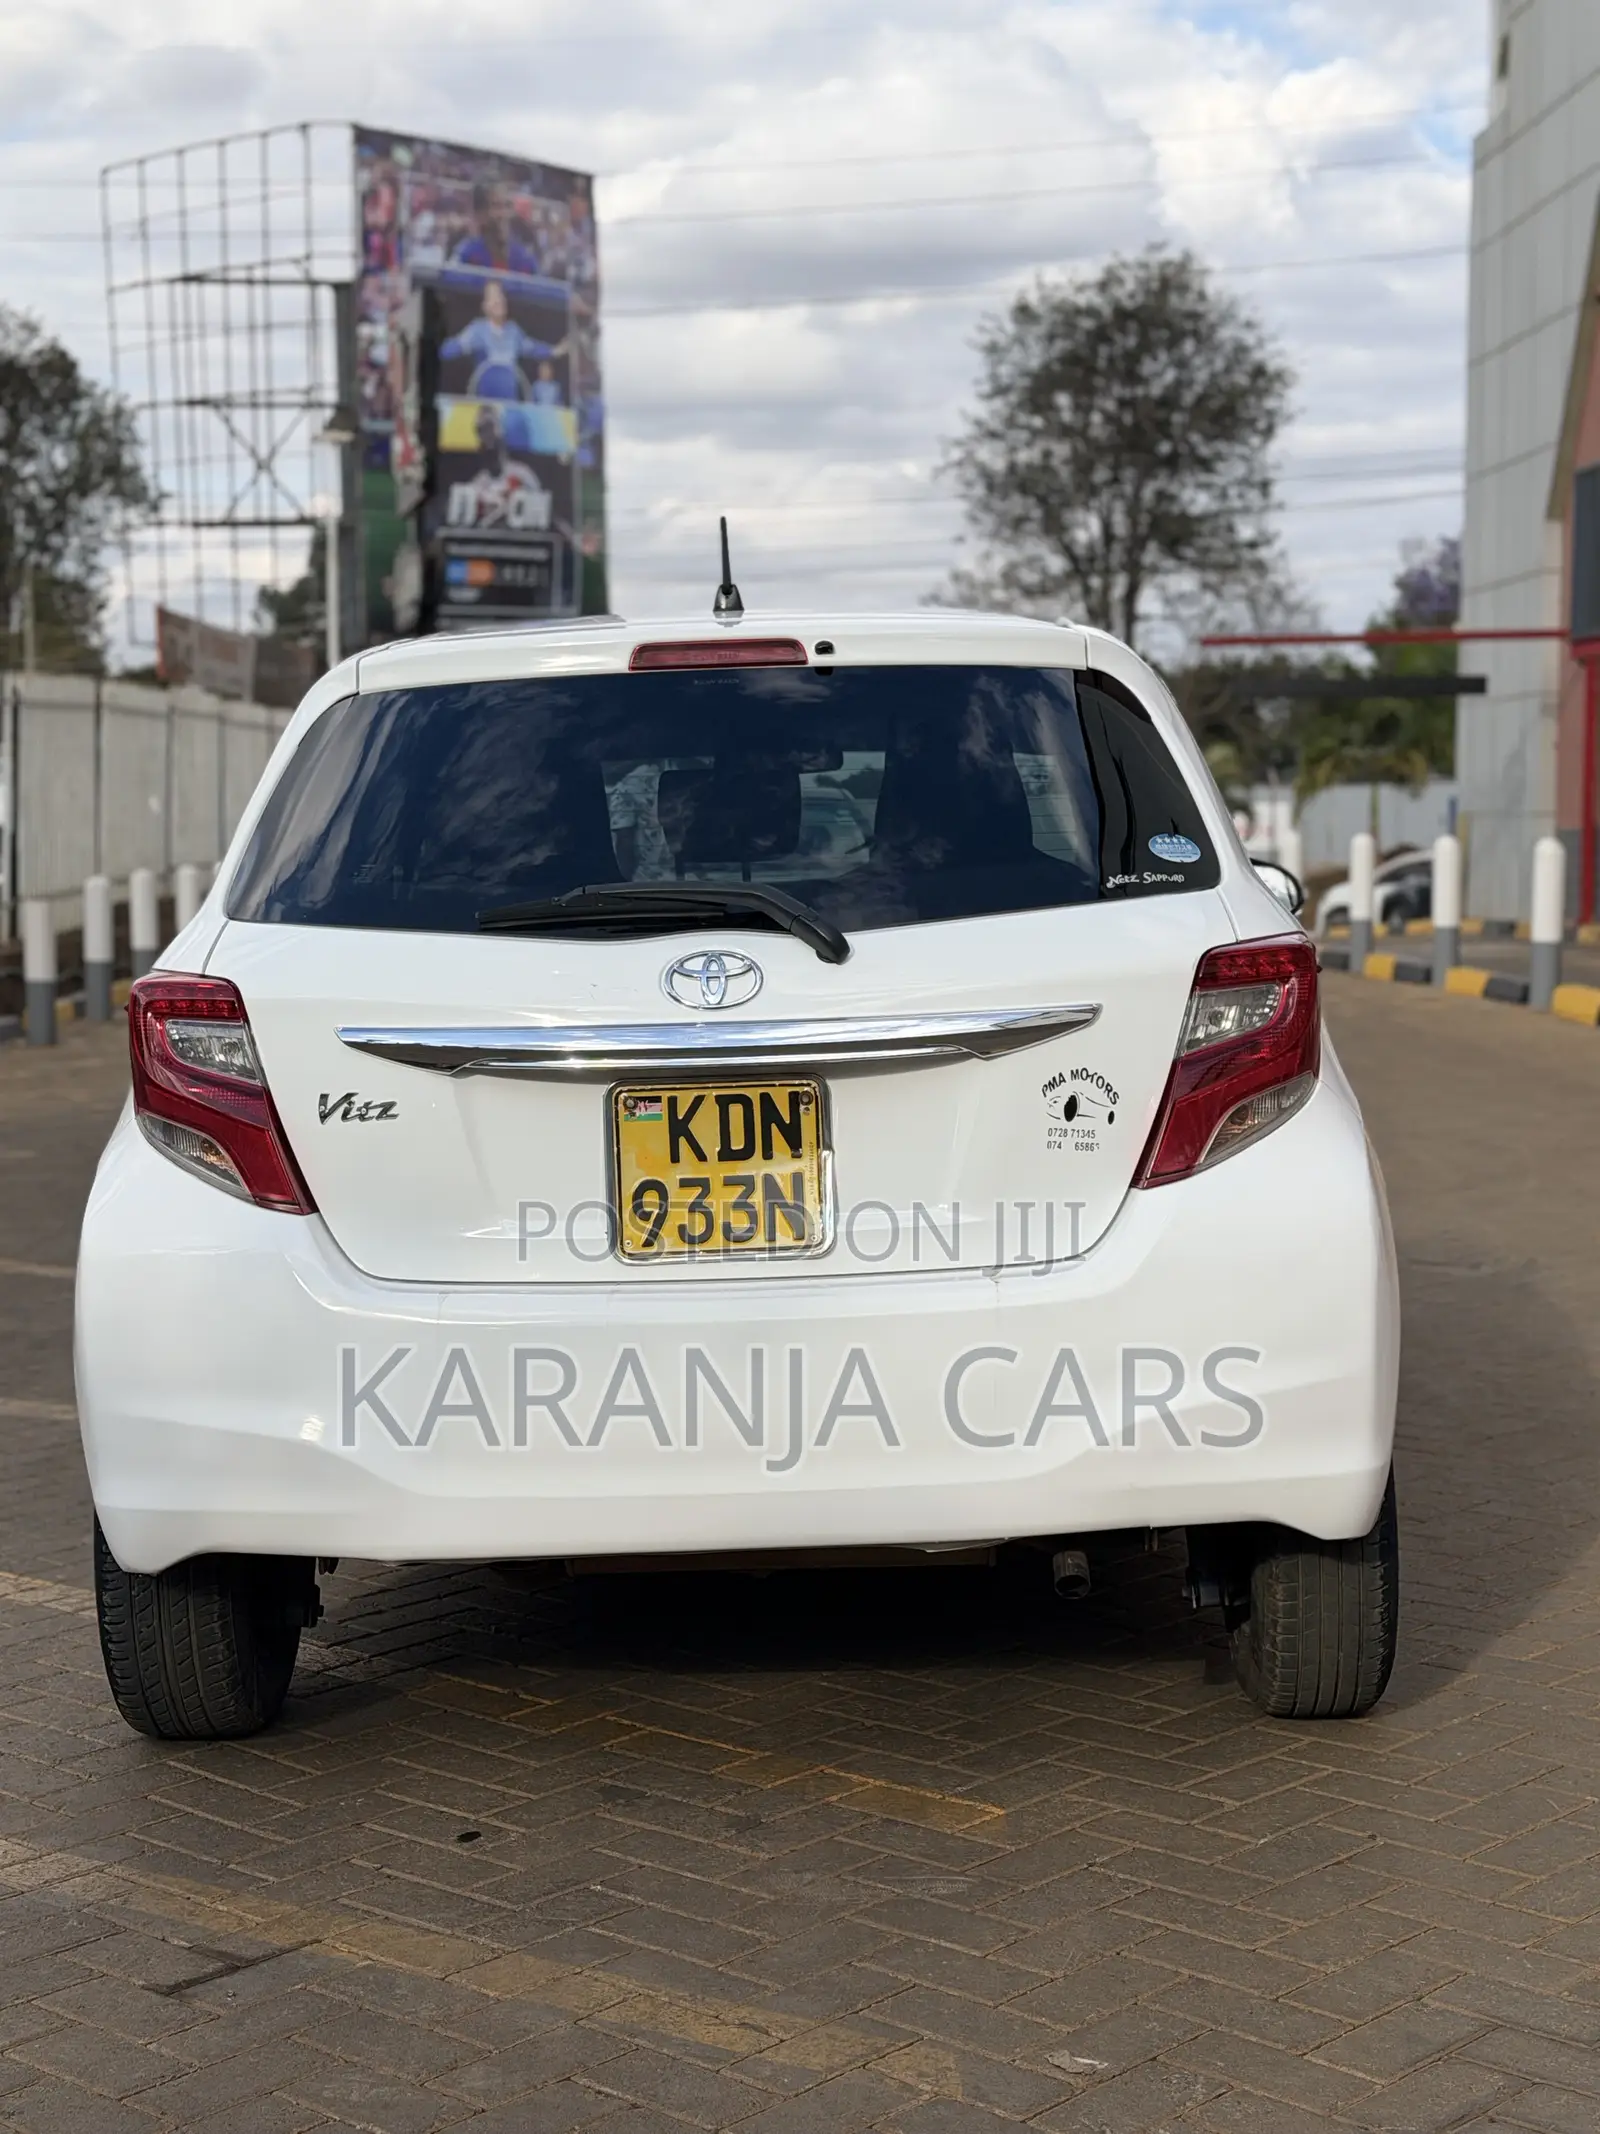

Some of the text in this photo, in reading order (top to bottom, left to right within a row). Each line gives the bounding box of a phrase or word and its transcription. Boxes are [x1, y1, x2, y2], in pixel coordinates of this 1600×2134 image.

[318, 1092, 400, 1125] Vitz
[1041, 1067, 1120, 1105] PMA MOTORS
[666, 1091, 803, 1164] KDN
[631, 1171, 805, 1248] 933N
